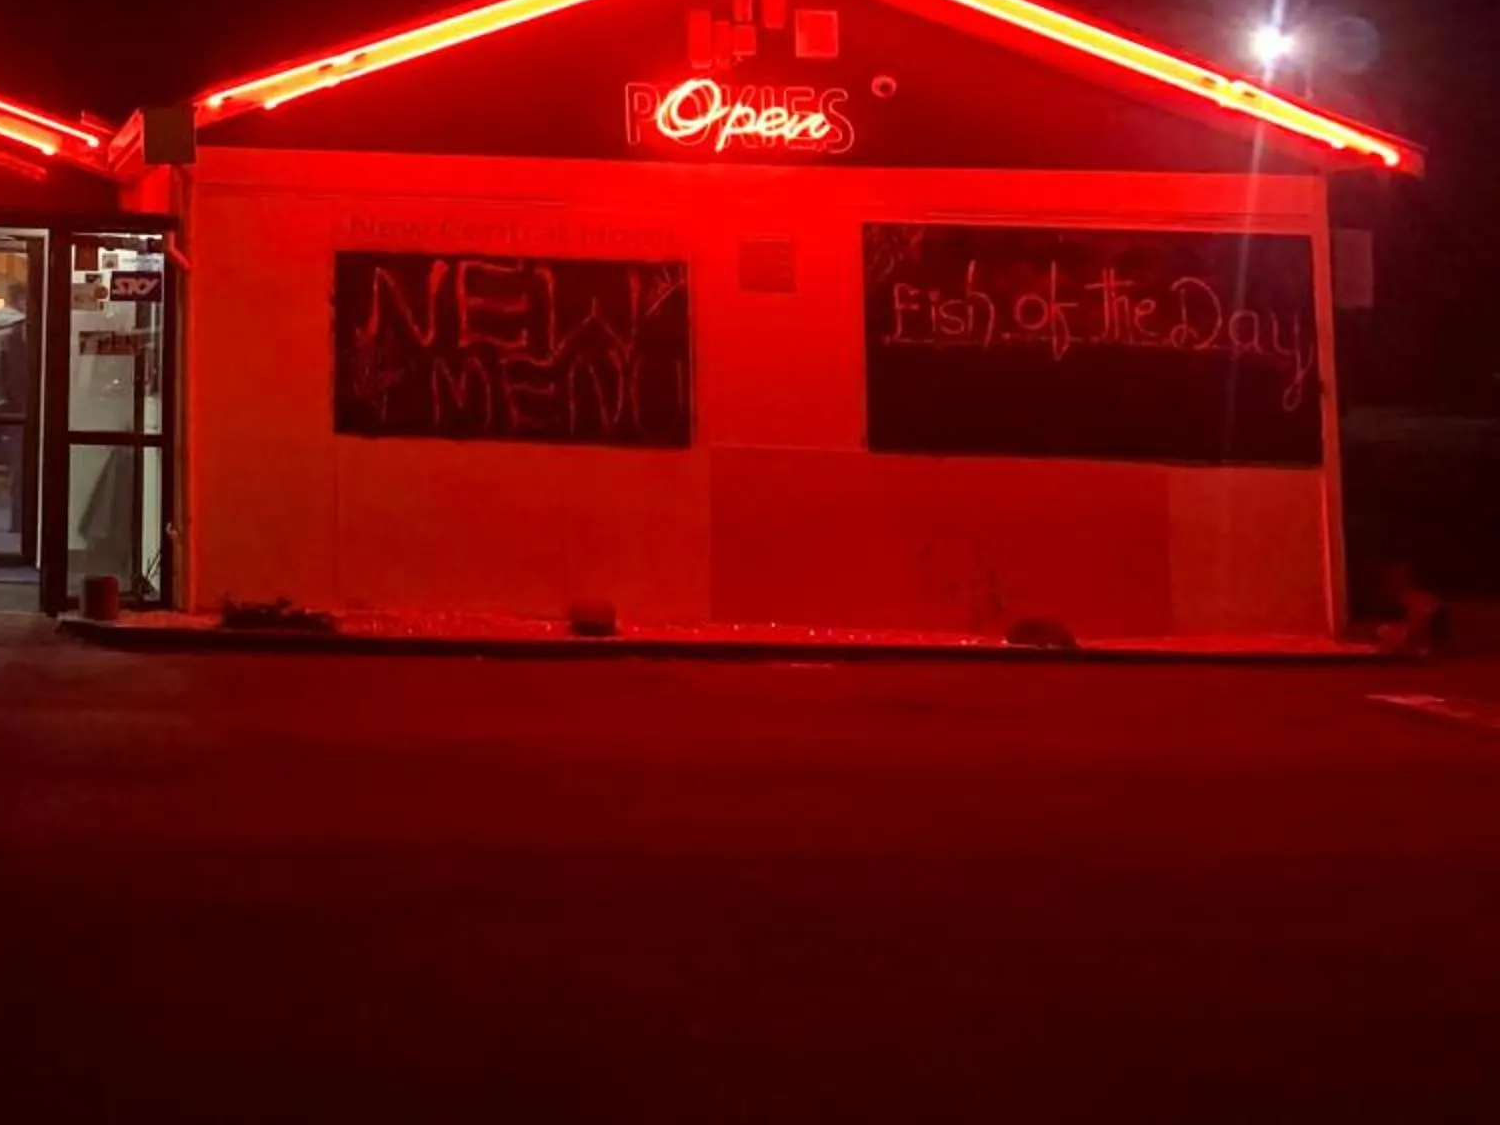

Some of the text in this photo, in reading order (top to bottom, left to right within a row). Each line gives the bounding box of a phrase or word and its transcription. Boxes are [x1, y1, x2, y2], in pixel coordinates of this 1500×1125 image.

[656, 77, 831, 153] Open
[1012, 258, 1079, 361] of
[1169, 275, 1314, 412] Day
